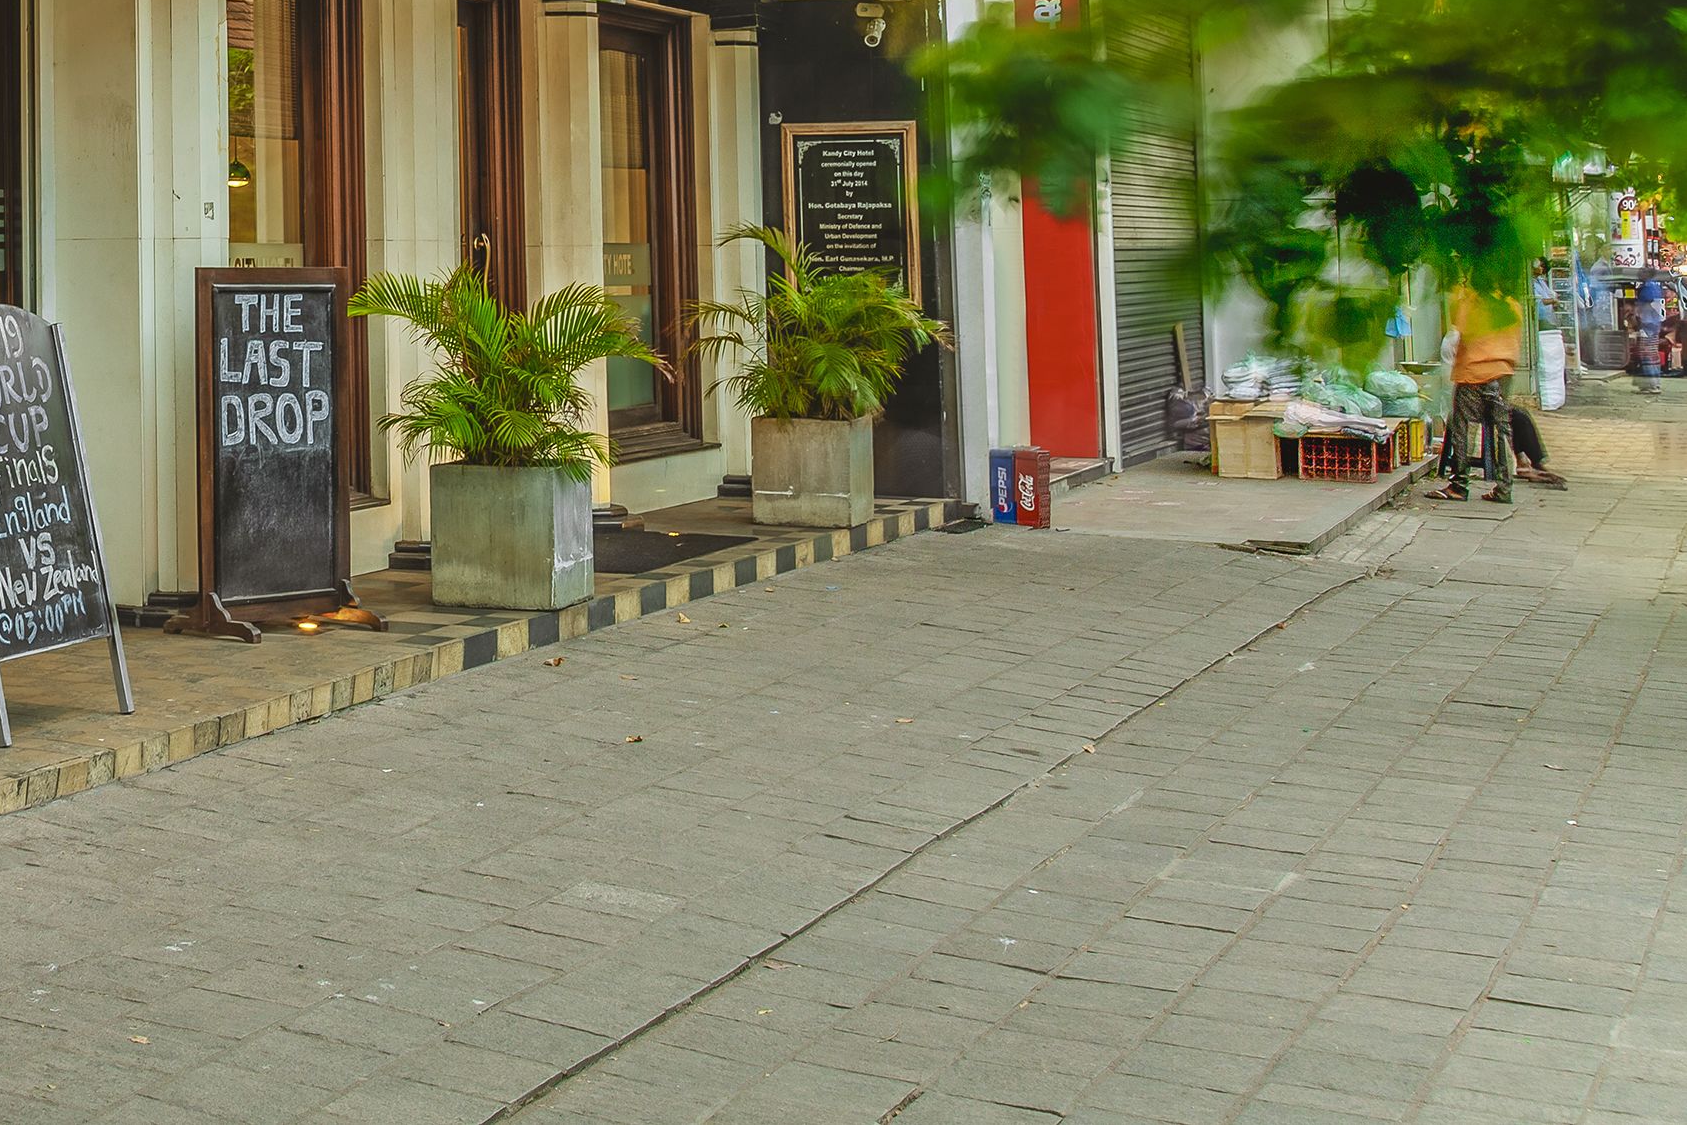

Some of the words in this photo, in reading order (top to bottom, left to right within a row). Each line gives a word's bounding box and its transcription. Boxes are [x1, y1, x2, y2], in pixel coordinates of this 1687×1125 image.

[822, 150, 842, 158] Kandy
[843, 150, 856, 158] City
[857, 149, 875, 157] Hotel
[855, 160, 877, 168] opened
[853, 171, 864, 179] day
[842, 180, 854, 188] July
[845, 190, 854, 198] by
[824, 202, 856, 210] Gotabaya
[857, 202, 892, 210] Rajapaksa
[837, 213, 864, 221] Secretary
[234, 294, 303, 333] THE
[220, 338, 324, 388] LAST
[221, 390, 330, 446] DROP
[997, 466, 1008, 513] PEPSI
[40, 550, 101, 601] Zealand
